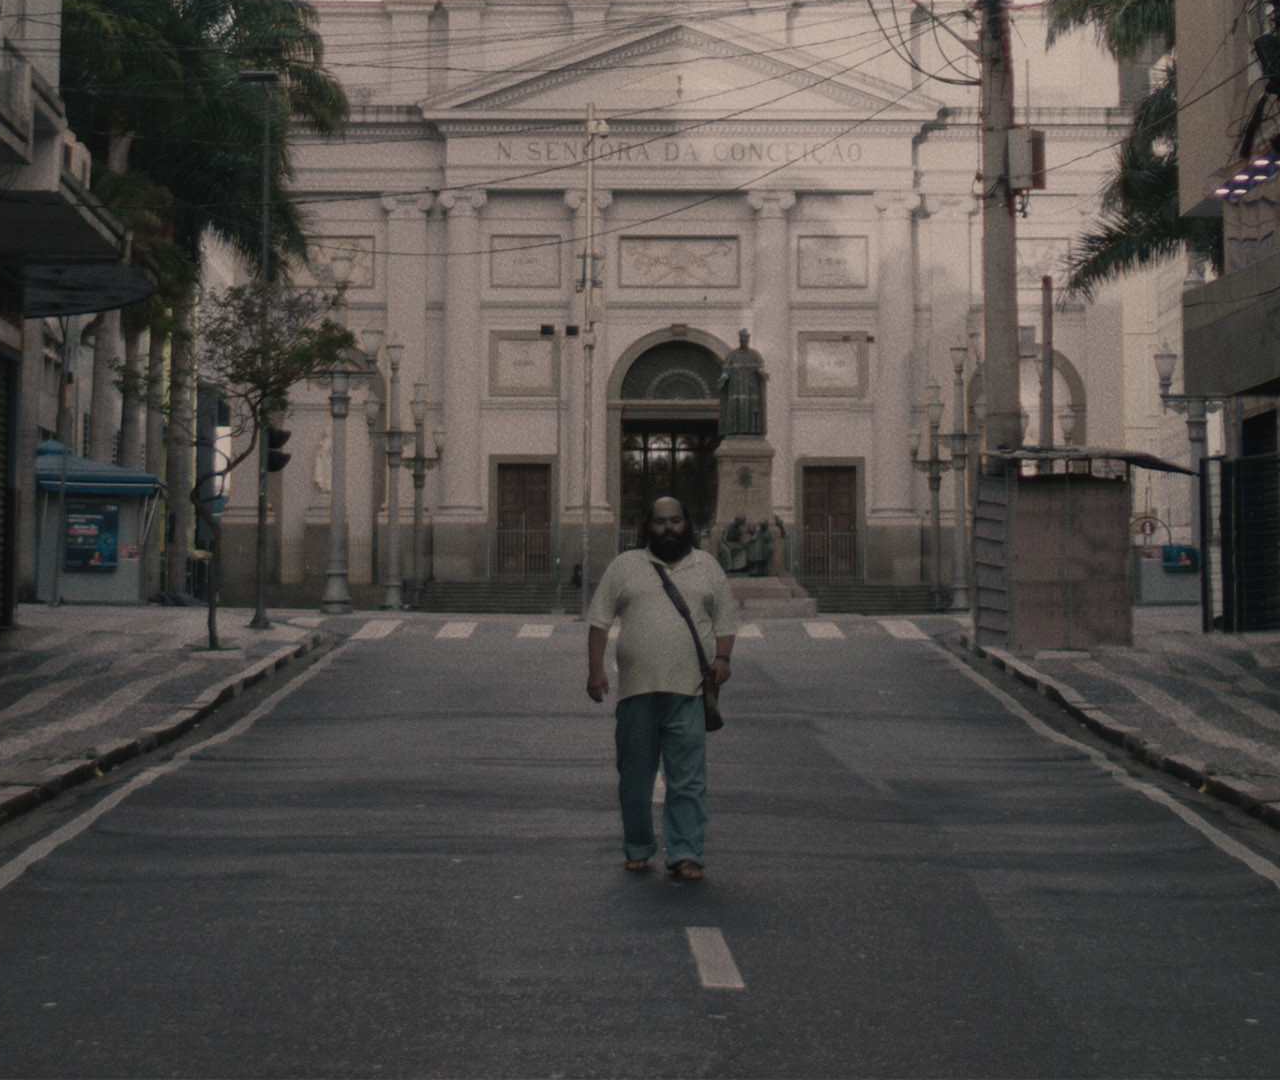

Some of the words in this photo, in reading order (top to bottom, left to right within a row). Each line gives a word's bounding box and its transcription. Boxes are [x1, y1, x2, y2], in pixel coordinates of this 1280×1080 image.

[527, 140, 651, 162] SENORA
[664, 141, 699, 162] DA
[713, 139, 863, 164] CONCEIÇÃO
